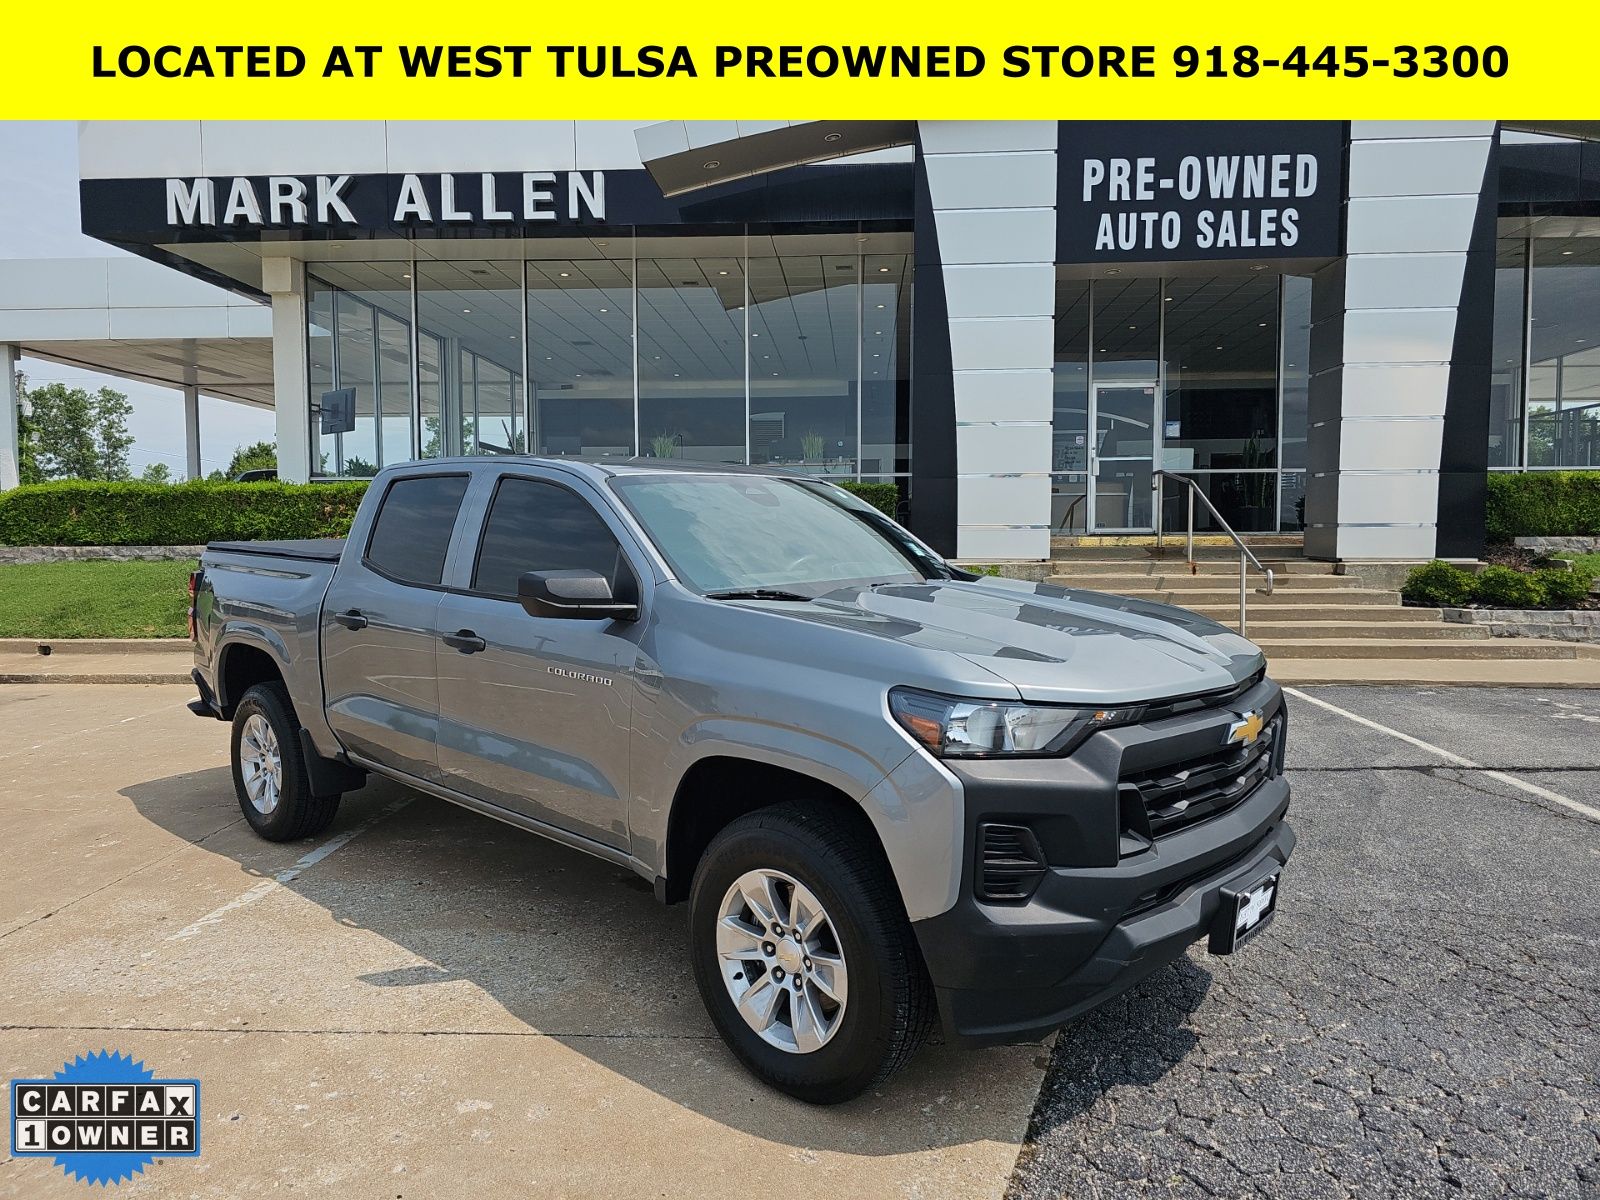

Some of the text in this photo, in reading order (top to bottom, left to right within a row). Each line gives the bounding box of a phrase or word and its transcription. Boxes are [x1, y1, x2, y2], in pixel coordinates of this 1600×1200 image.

[165, 170, 606, 226] MARK ALLEN
[1082, 153, 1318, 202] PRE-OWNED
[1094, 207, 1300, 251] AUTO SALES
[547, 666, 613, 687] COLORADO
